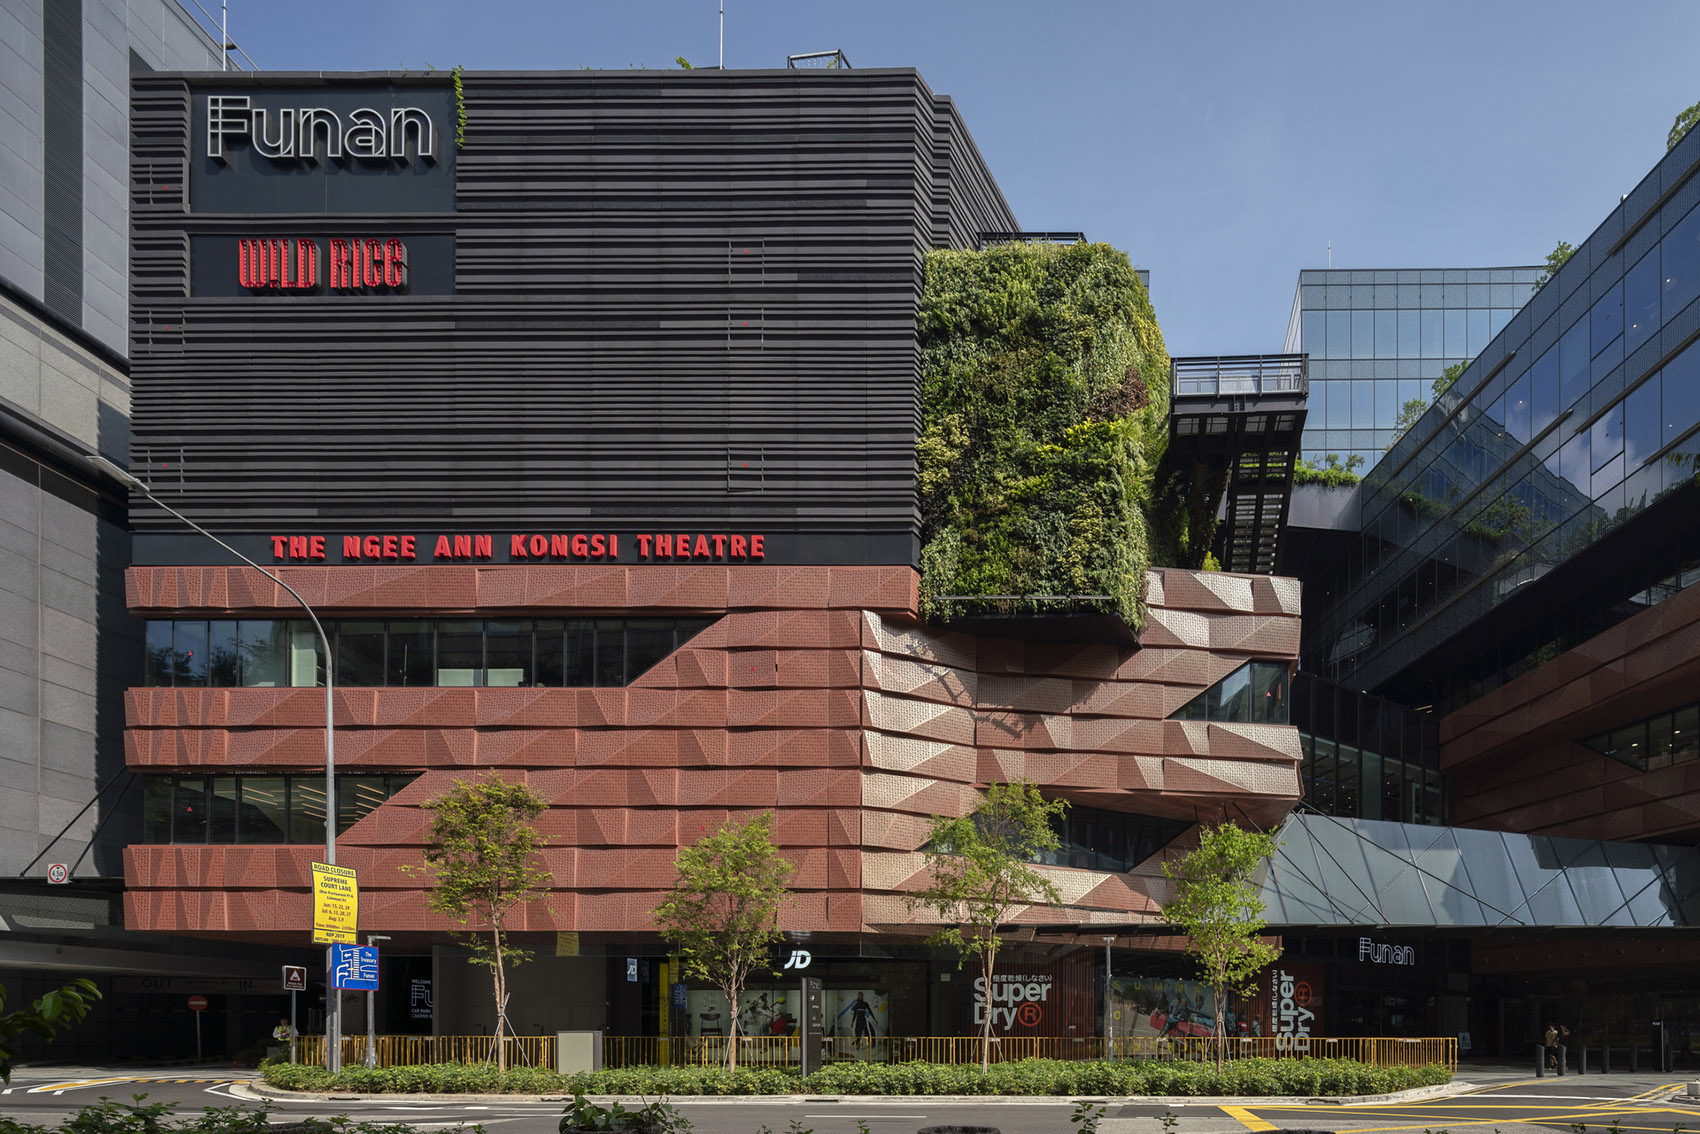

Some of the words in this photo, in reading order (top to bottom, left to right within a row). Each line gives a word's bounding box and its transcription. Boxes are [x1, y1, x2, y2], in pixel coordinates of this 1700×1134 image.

[207, 95, 433, 158] Funan
[239, 239, 318, 288] WILD
[330, 239, 404, 288] RICE
[271, 535, 326, 559] THE
[343, 535, 417, 559] NGEE
[434, 535, 493, 559] ANN
[511, 534, 618, 558] KONGSI
[637, 534, 765, 558] THEATRE
[323, 876, 347, 885] SUPREME
[331, 867, 354, 876] CLOSURE
[784, 950, 812, 969] JD
[1360, 937, 1415, 965] Funan
[628, 965, 638, 975] JD
[973, 977, 1052, 1007] Super
[1276, 970, 1298, 1051] Super
